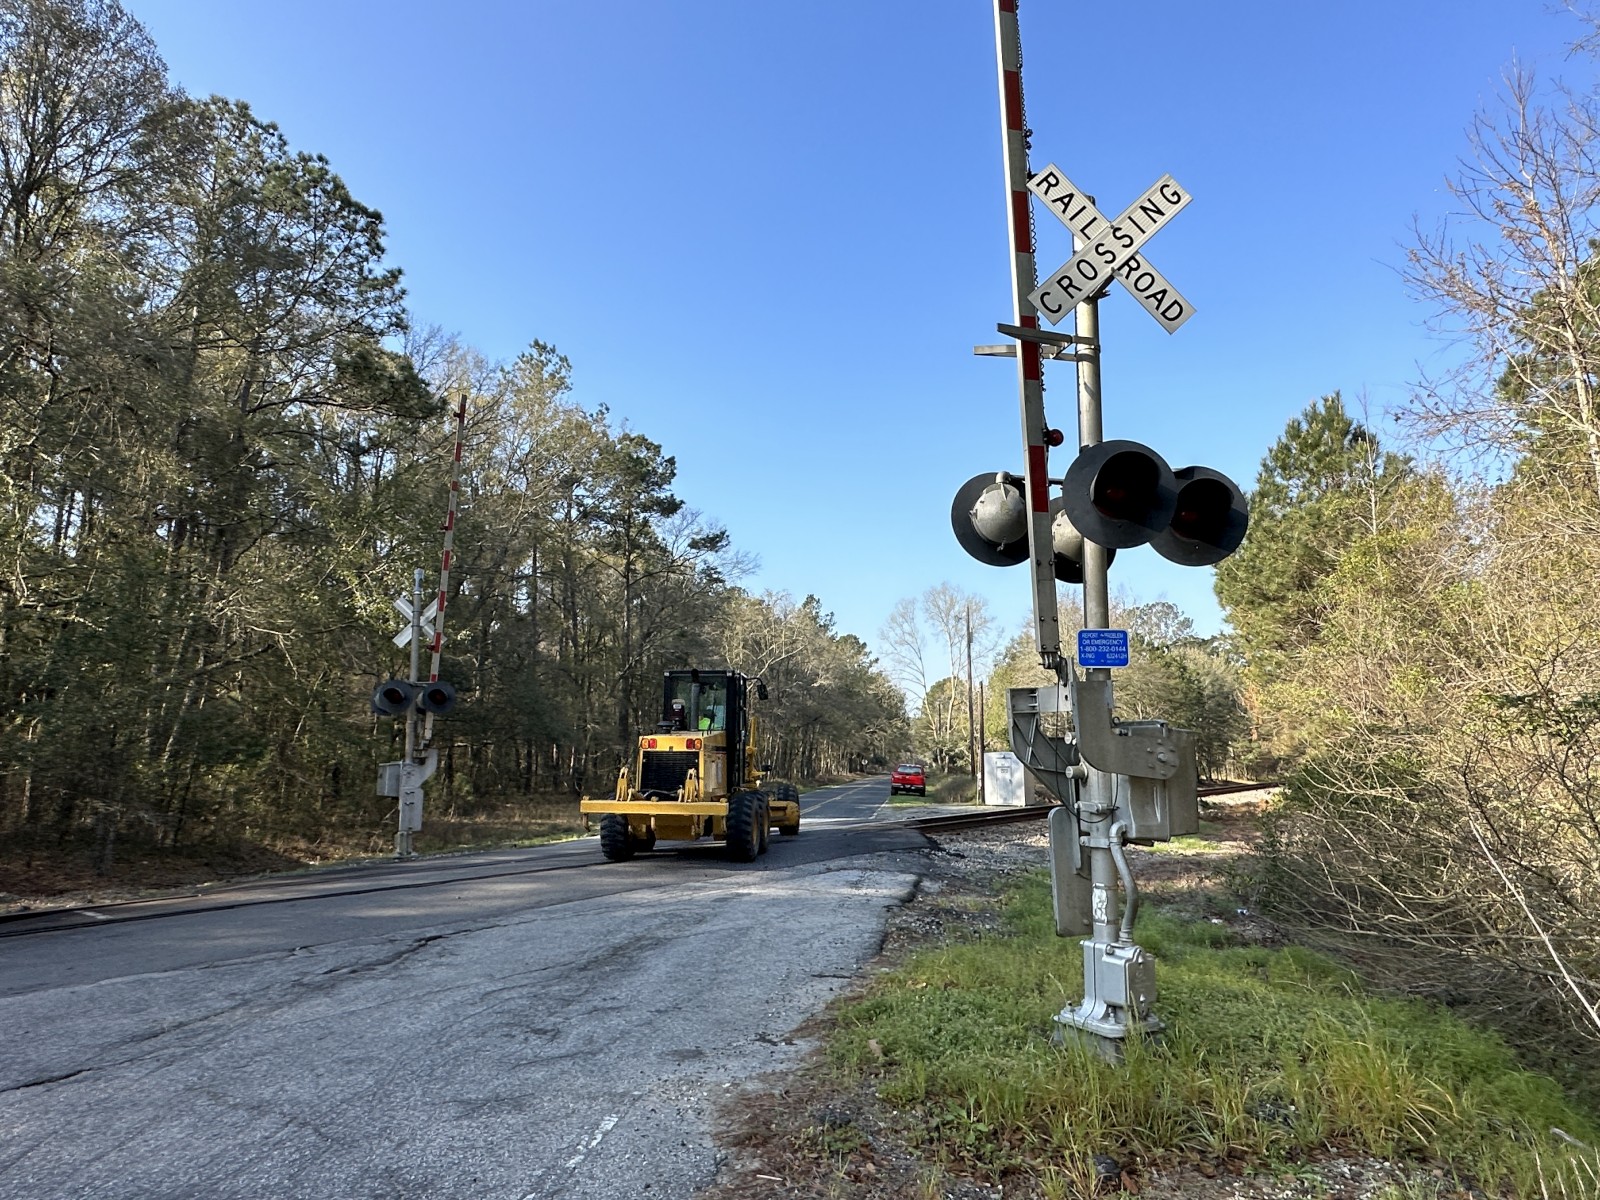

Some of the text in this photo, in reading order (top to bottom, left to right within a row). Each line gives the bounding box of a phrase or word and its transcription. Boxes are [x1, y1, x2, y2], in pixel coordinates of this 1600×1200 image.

[1036, 171, 1184, 322] RAIL ROAD
[1039, 183, 1182, 314] CROSSING
